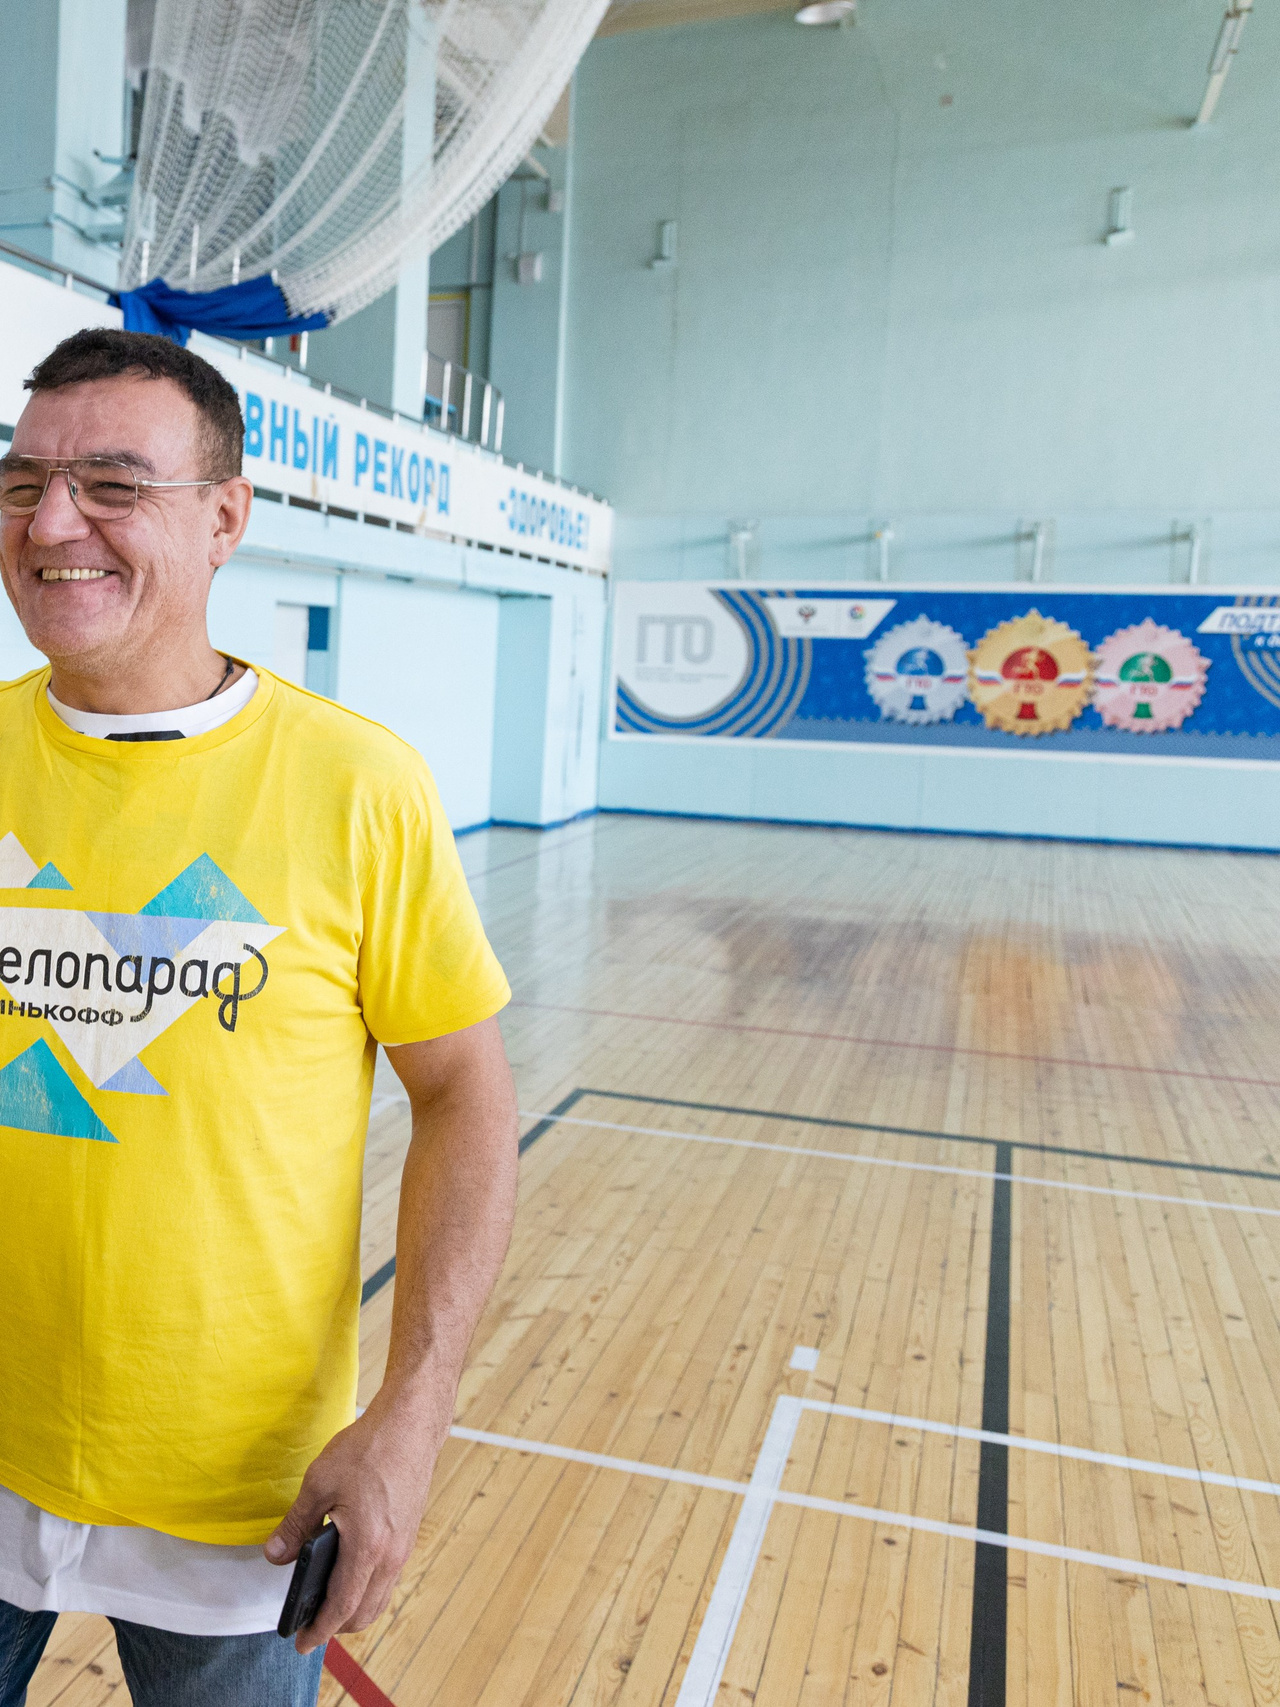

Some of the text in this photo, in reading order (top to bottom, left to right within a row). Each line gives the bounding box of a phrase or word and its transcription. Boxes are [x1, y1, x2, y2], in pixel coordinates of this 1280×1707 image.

[233, 386, 339, 481] ВНЫЙ
[353, 431, 451, 516] РЕКОРД
[637, 614, 714, 664] ГТО
